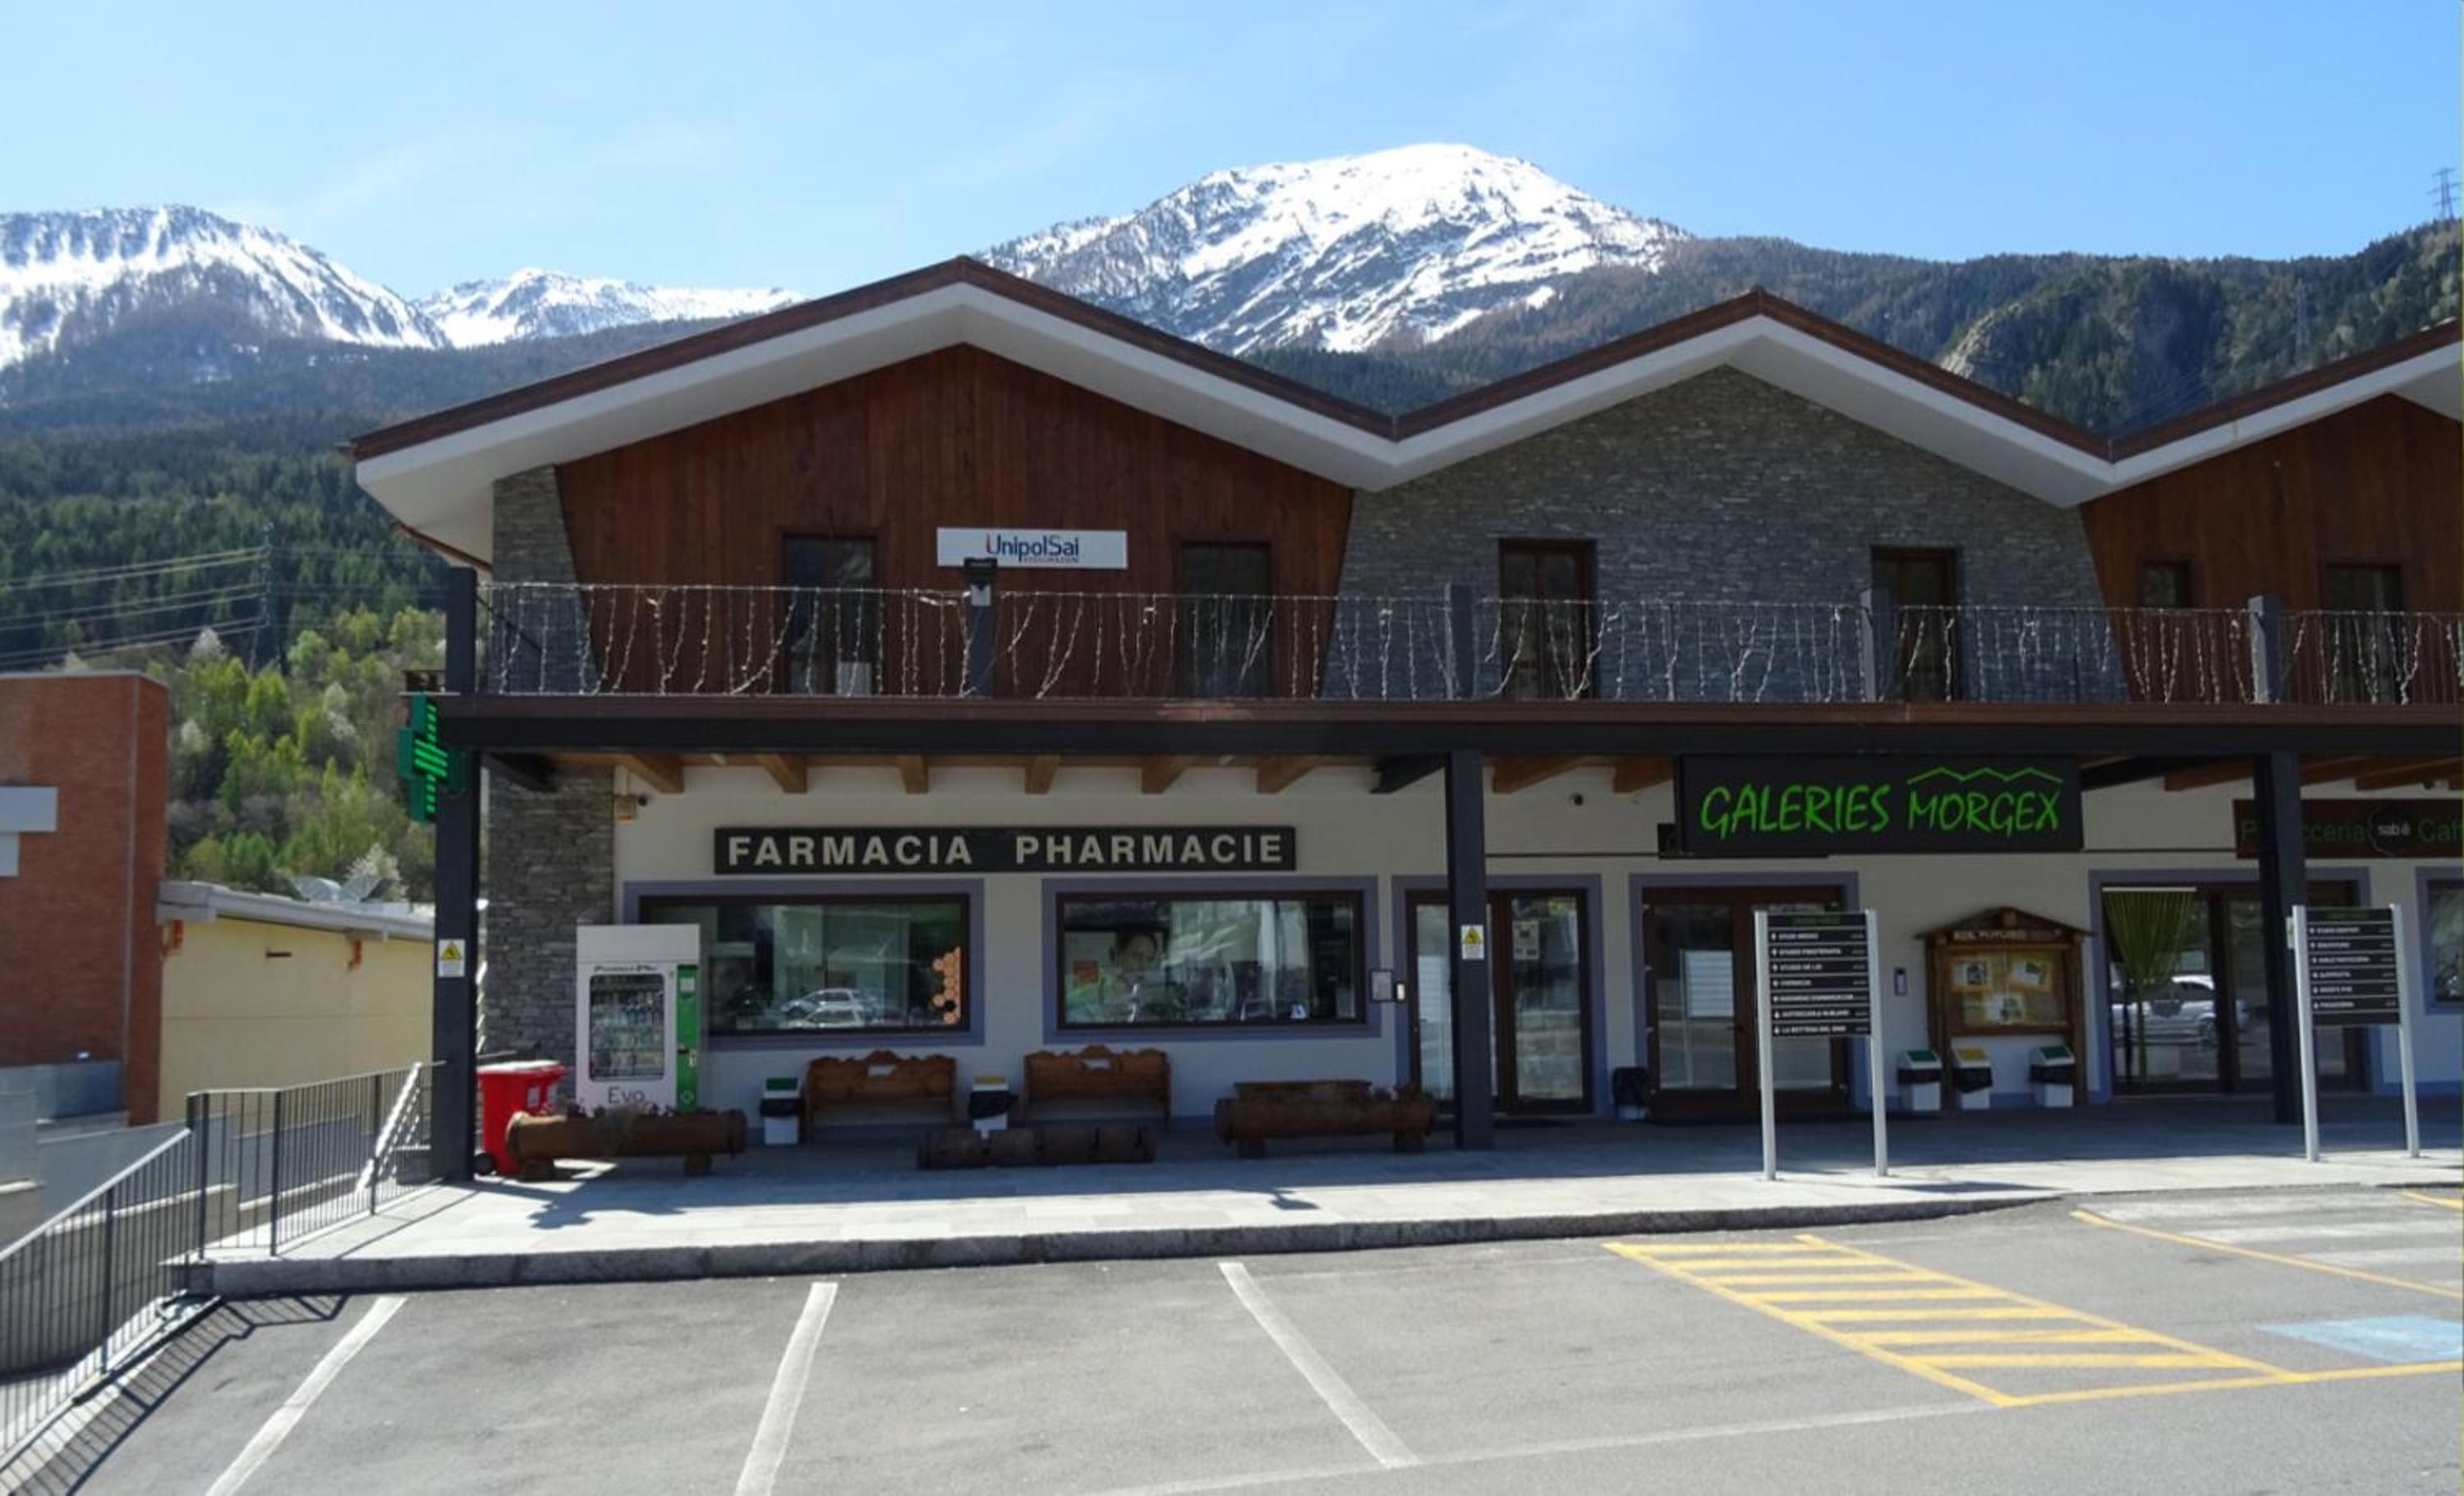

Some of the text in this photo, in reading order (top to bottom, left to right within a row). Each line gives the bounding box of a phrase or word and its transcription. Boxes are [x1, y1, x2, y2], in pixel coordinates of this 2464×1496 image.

[986, 534, 1078, 562] UnipolSai
[1700, 783, 2061, 840] GALERIES MORGEX
[729, 834, 1283, 866] FARMACIA PHARMACIE
[608, 1085, 646, 1104] Evo
